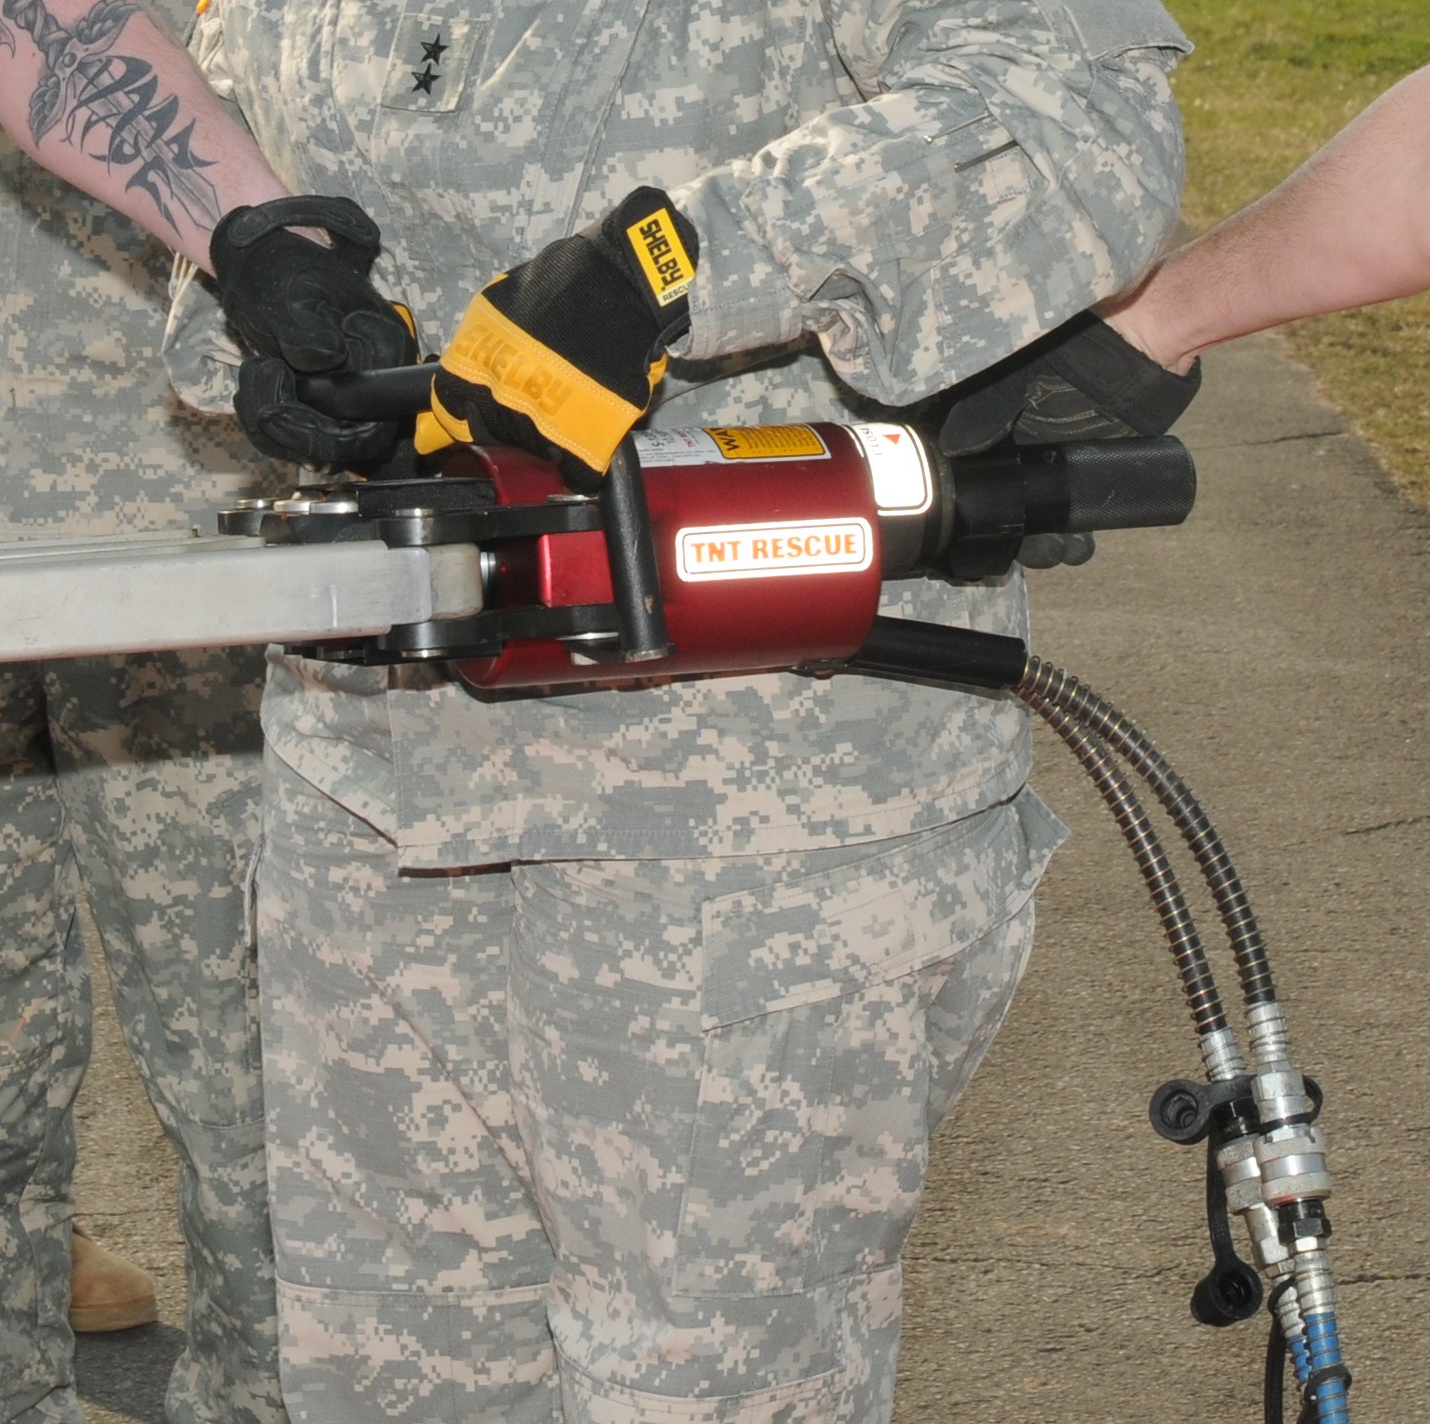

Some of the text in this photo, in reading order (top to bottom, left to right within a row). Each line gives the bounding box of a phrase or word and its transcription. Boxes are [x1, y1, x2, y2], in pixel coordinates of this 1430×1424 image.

[638, 218, 685, 287] SHELBY
[454, 322, 573, 417] SHELBY
[690, 533, 858, 564] TNT RESCUE
